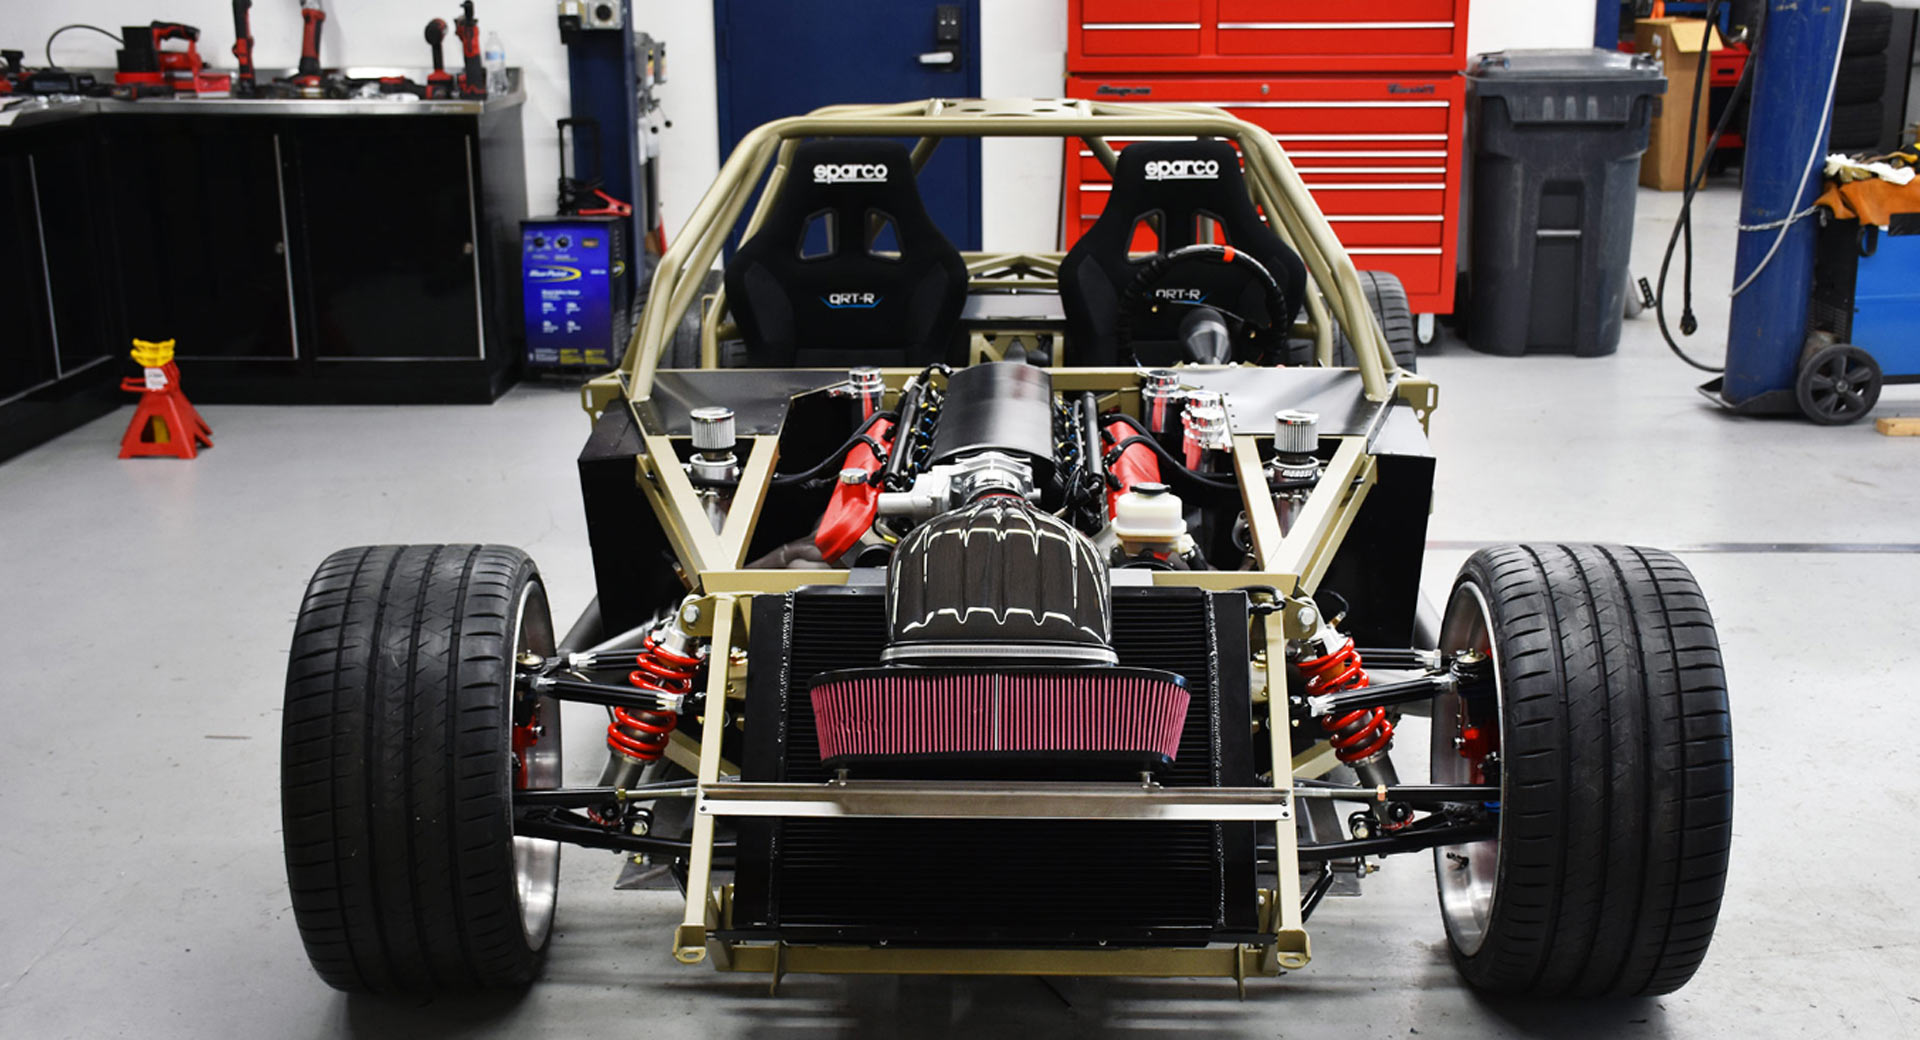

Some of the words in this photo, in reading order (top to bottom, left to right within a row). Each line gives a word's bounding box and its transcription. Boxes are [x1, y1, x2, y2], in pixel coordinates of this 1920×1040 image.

[813, 164, 888, 184] sparco
[1145, 160, 1219, 181] sparco
[829, 293, 875, 305] QRT-R
